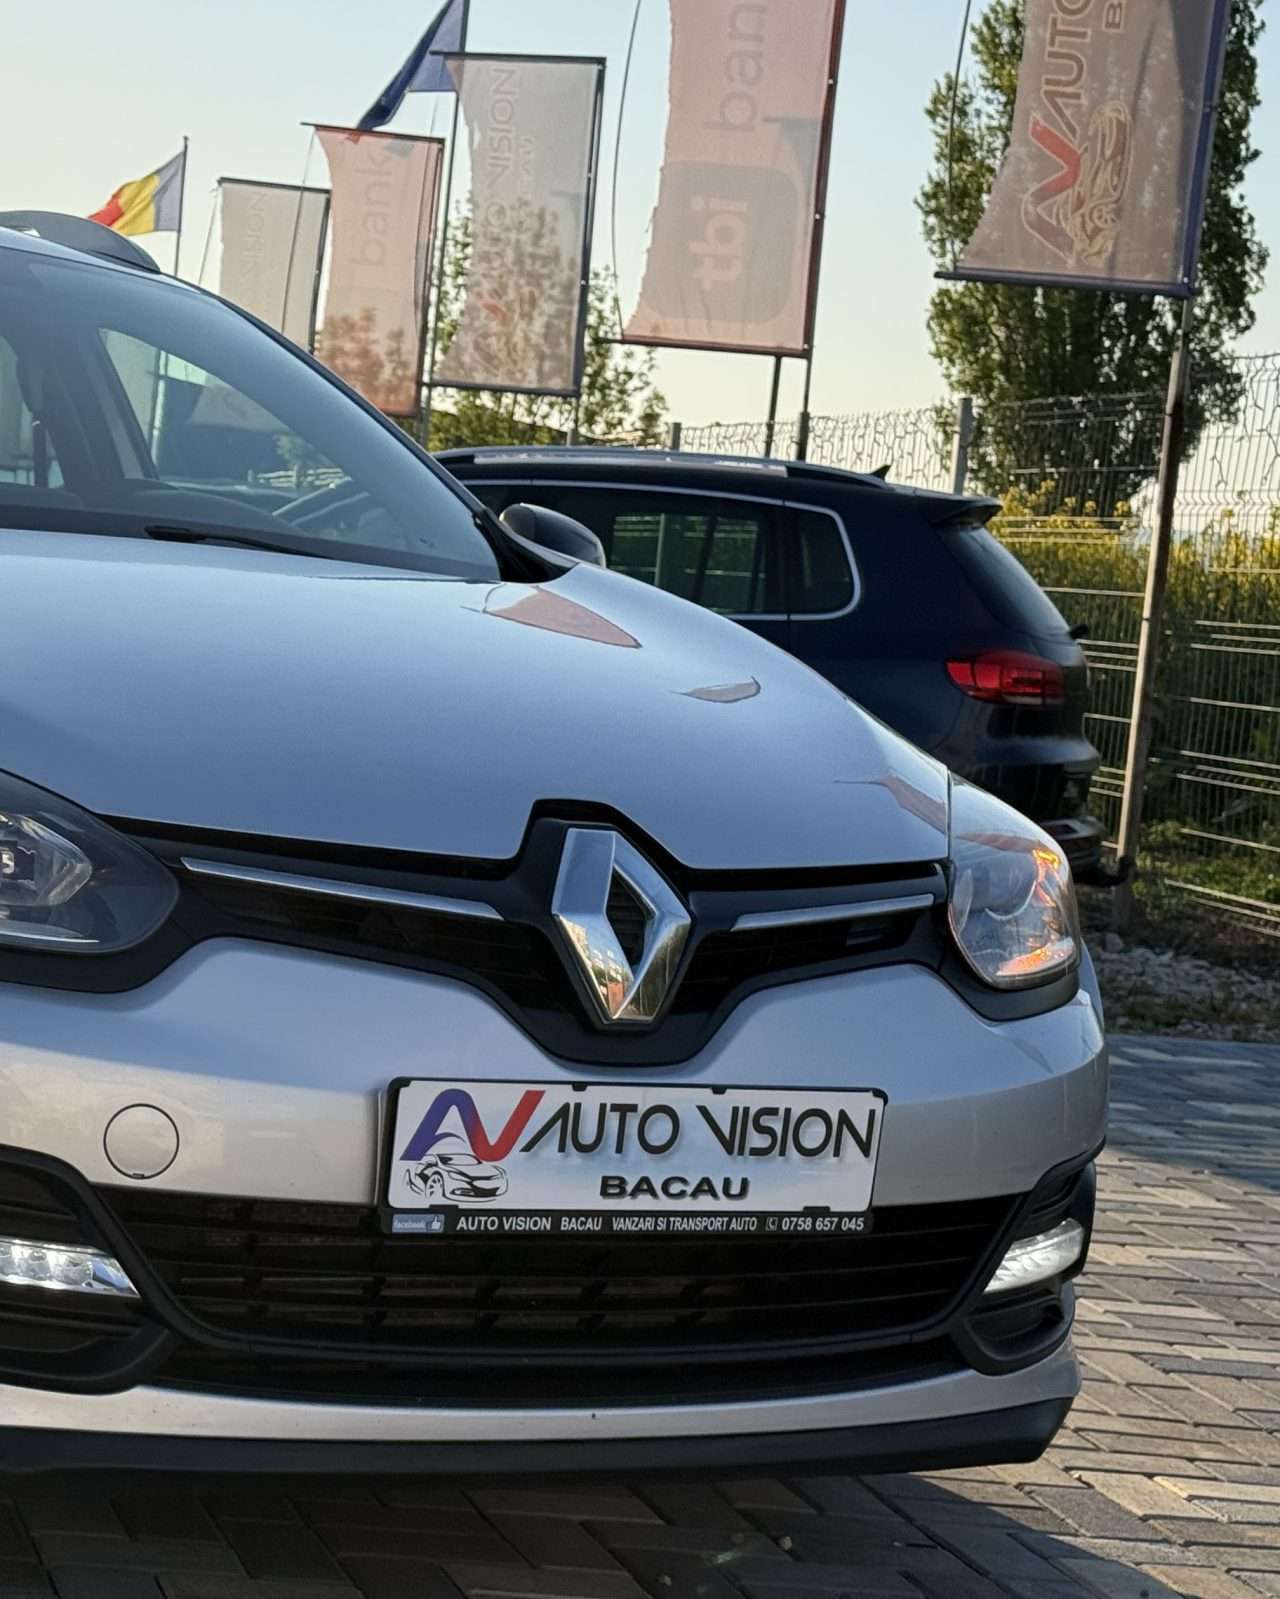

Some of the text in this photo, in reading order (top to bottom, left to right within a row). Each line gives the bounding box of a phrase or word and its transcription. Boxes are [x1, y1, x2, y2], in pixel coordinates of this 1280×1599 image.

[486, 68, 517, 190] VISION
[347, 141, 393, 267] bank
[689, 194, 748, 291] tbi
[519, 1102, 680, 1154] AUTO
[696, 1105, 876, 1158] VISION
[456, 1216, 865, 1231] AUTO VISION BACAU VANZARI SI TRANSPORT AUTO 0758 657 045
[599, 1176, 749, 1200] BACAU
